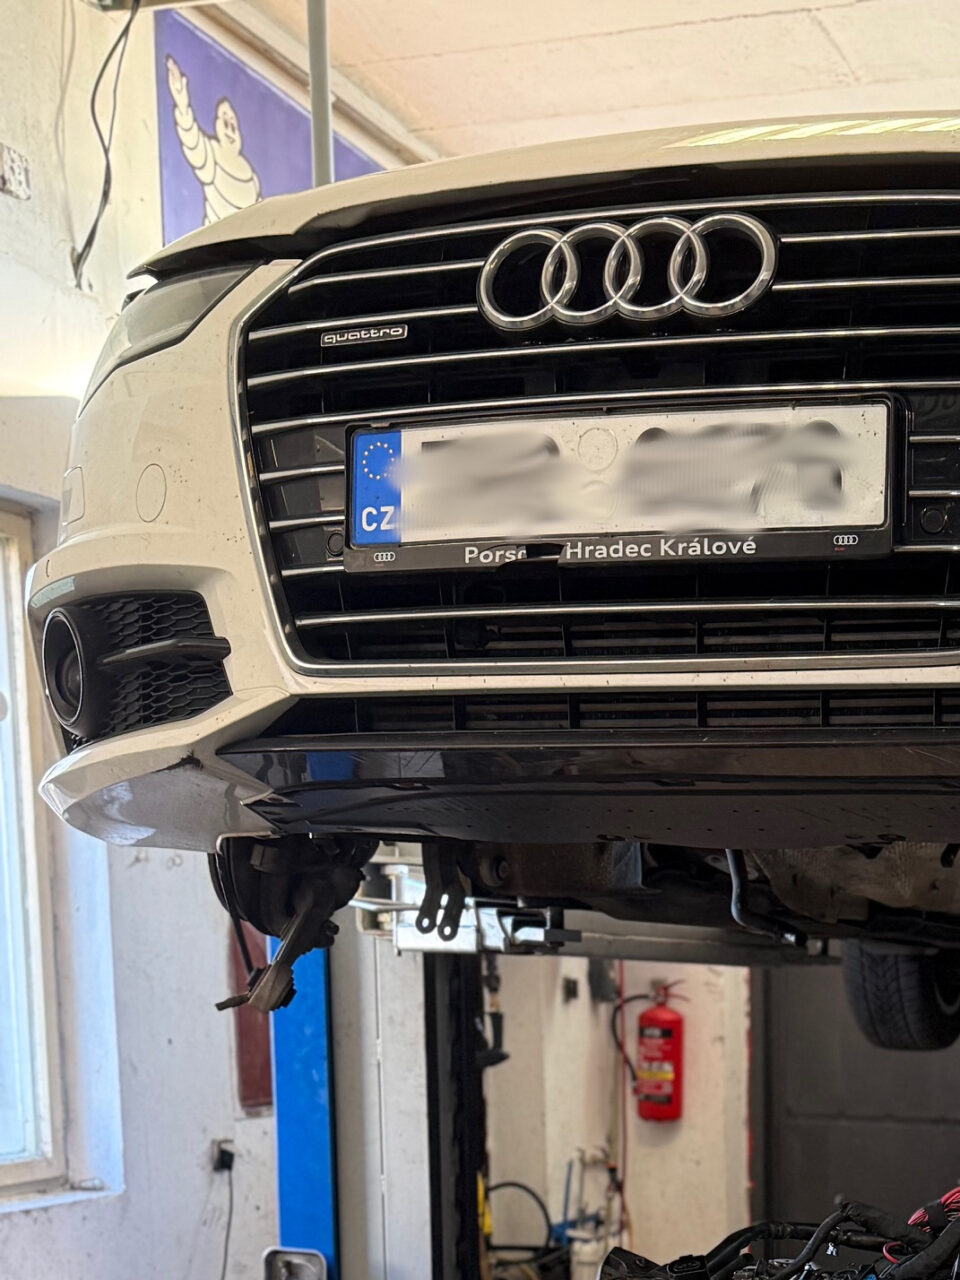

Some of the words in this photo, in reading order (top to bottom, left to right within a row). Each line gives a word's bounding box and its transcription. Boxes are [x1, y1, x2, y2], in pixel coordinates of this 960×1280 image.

[324, 327, 403, 343] quattro
[361, 506, 395, 531] CZ
[566, 540, 652, 559] Hradec
[660, 536, 757, 556] Králové
